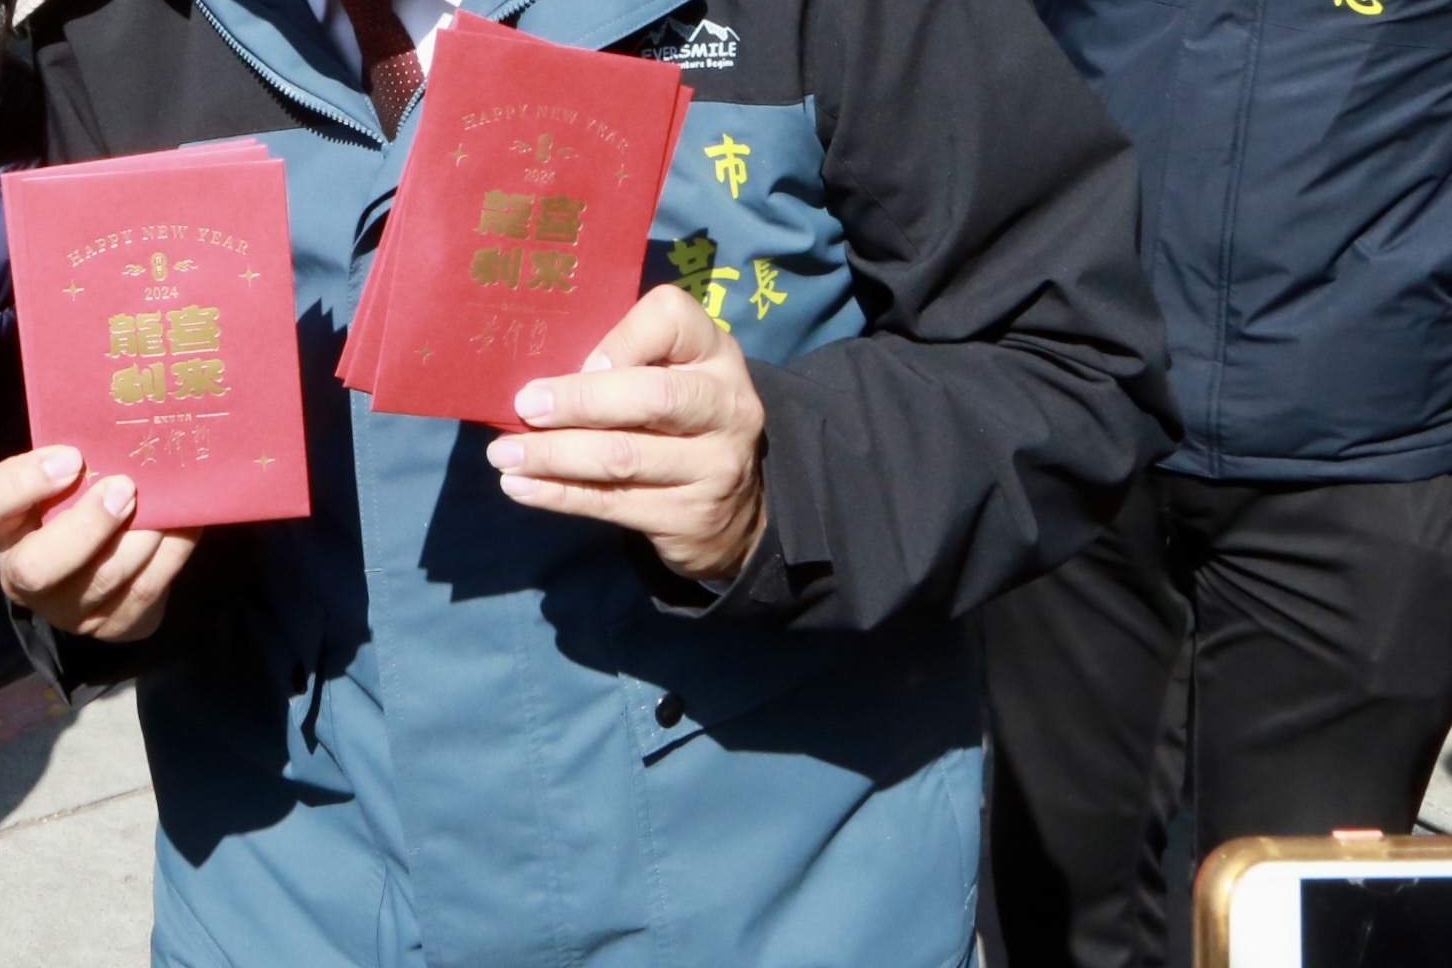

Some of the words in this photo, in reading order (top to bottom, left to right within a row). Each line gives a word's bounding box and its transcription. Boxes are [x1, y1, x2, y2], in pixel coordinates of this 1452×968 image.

[706, 57, 734, 70] Begins
[462, 104, 529, 131] HAPPY
[537, 105, 579, 124] NEW
[586, 119, 629, 153] YEAR
[524, 168, 557, 183] 2024
[66, 229, 133, 268] HAPPY
[141, 224, 189, 240] NEW
[197, 227, 250, 256] YEAR
[144, 285, 180, 301] 2024
